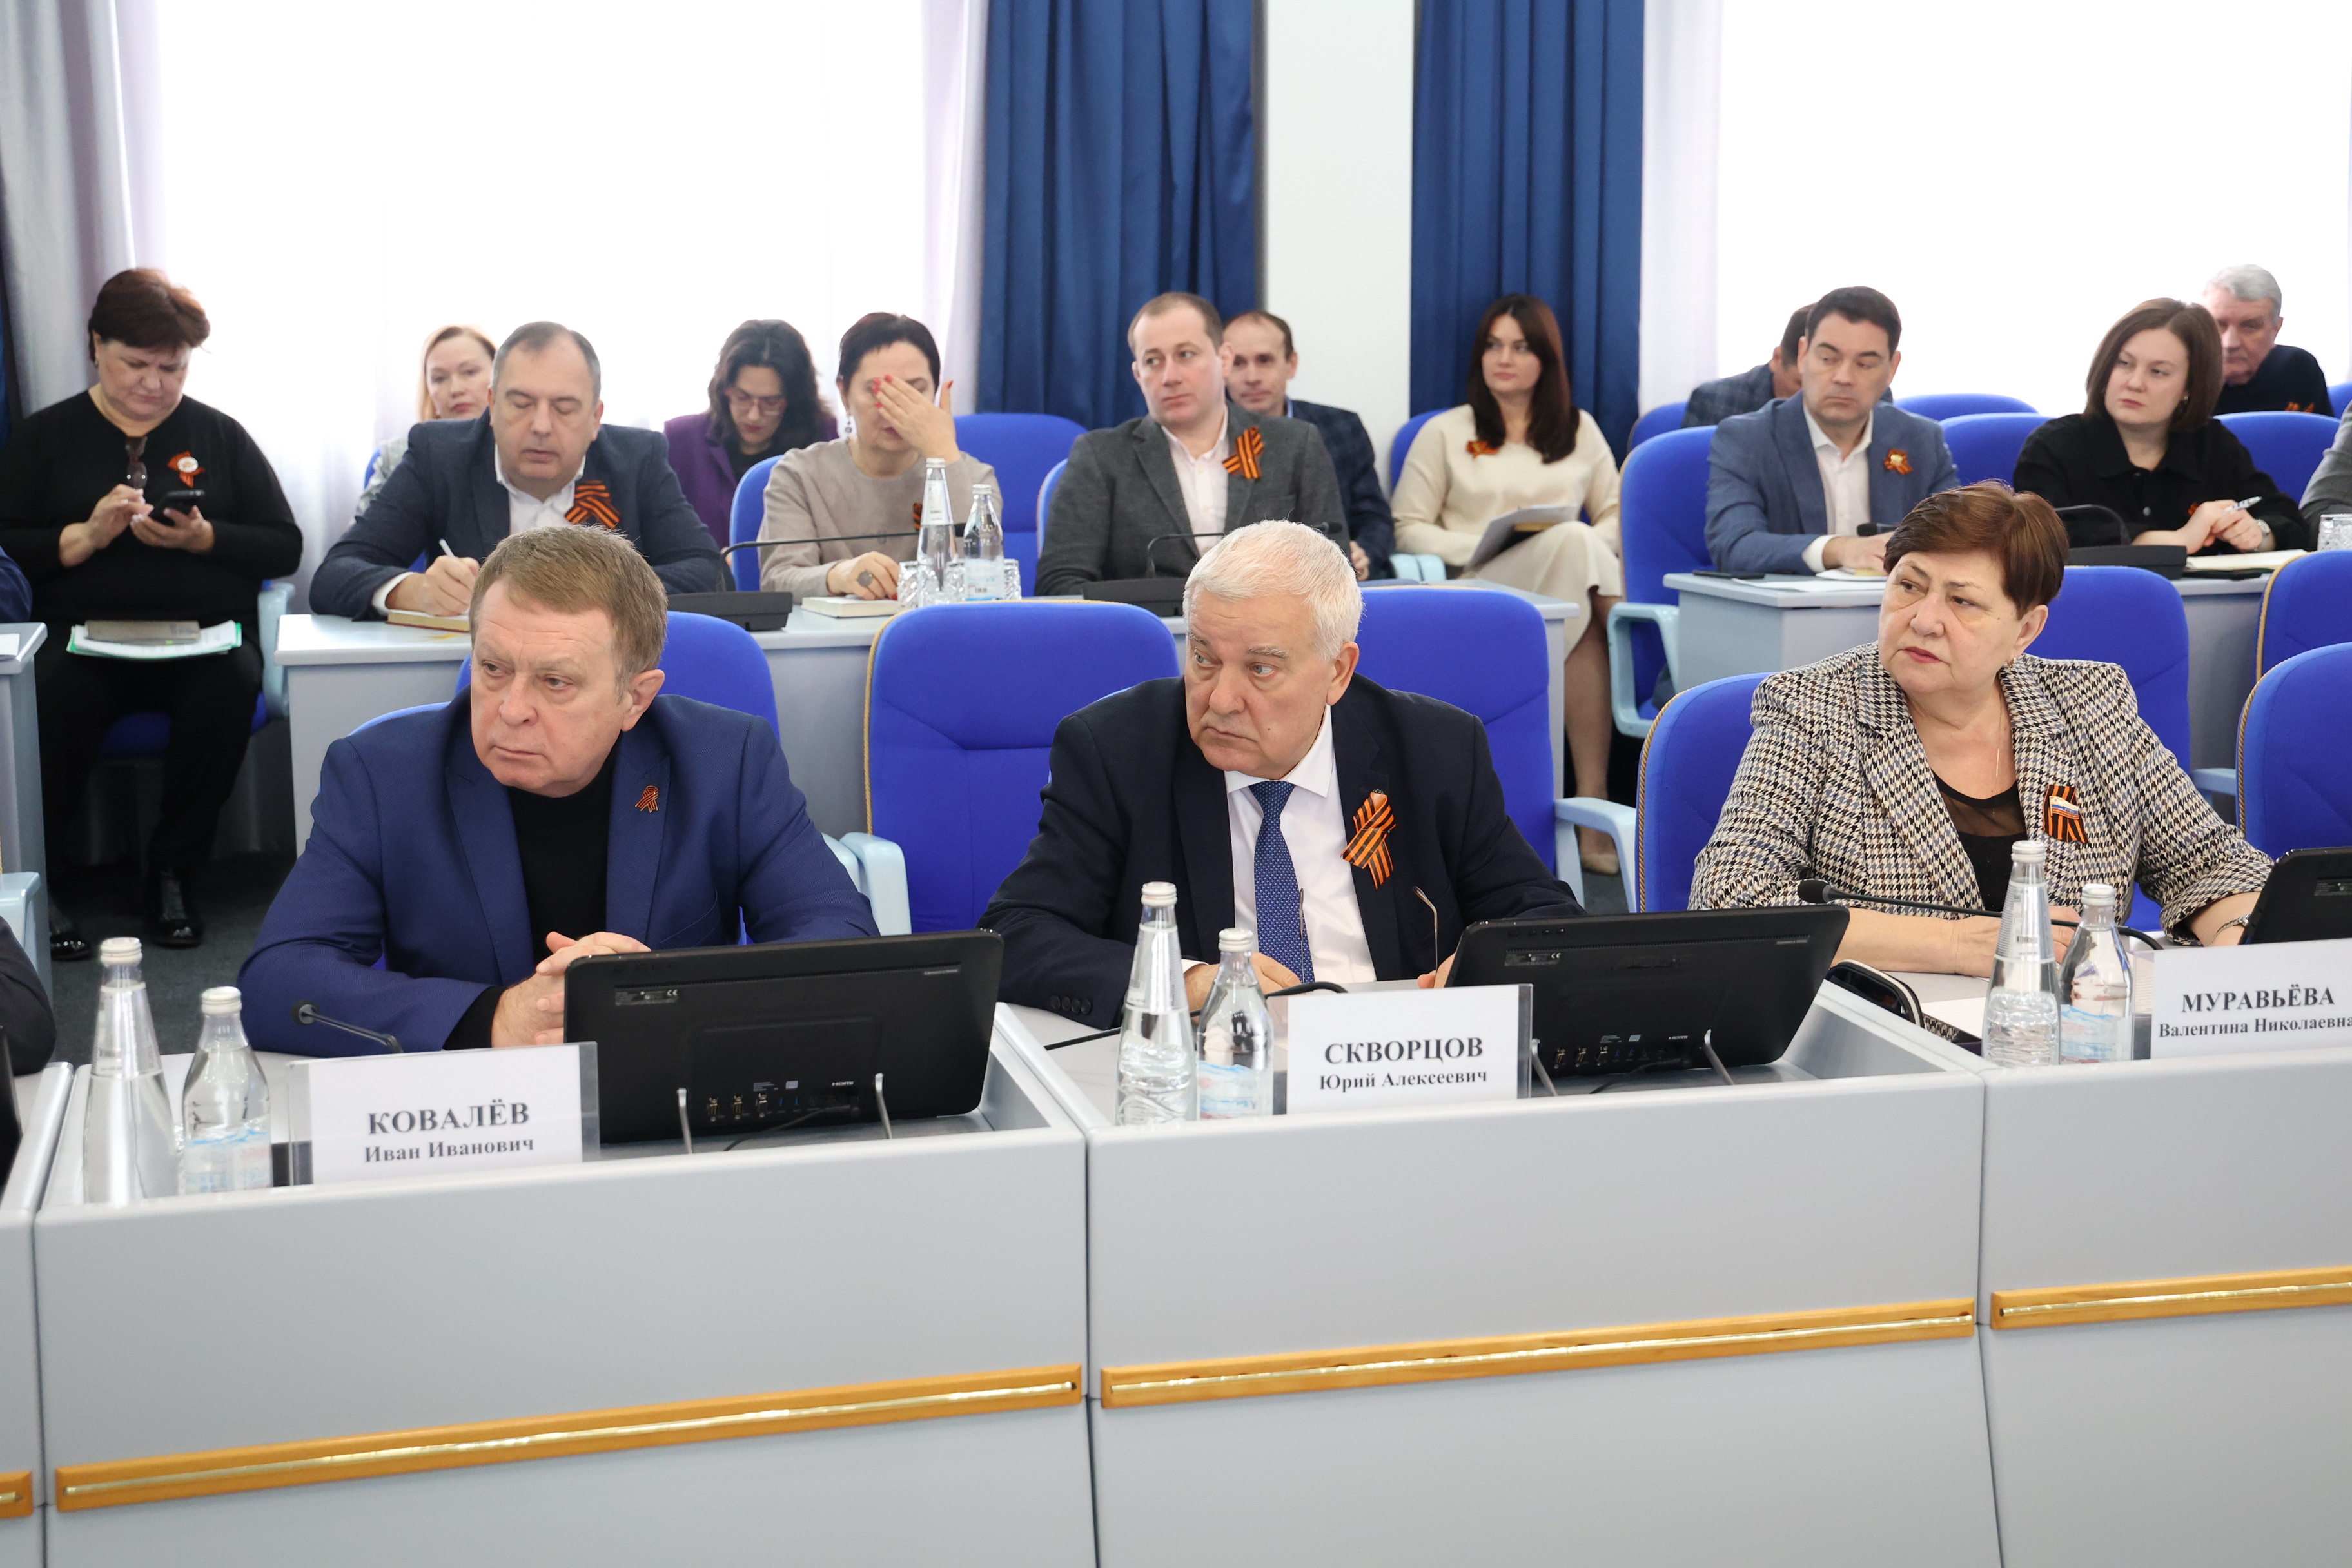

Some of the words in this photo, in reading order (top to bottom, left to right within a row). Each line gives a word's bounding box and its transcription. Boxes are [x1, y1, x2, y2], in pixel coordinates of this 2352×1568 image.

[2182, 984, 2335, 1012] МУРАВЬЁВА
[2159, 1023, 2248, 1037] Валентина
[2254, 1015, 2352, 1032] Николаевна
[1324, 1037, 1483, 1064] СКВОРЦОВ
[1320, 1073, 1375, 1093] Юрий
[1382, 1071, 1487, 1087] Алексеевич
[368, 1098, 529, 1135] КОВАЛЁВ
[365, 1146, 420, 1162] Иван
[429, 1139, 534, 1158] Иванович
